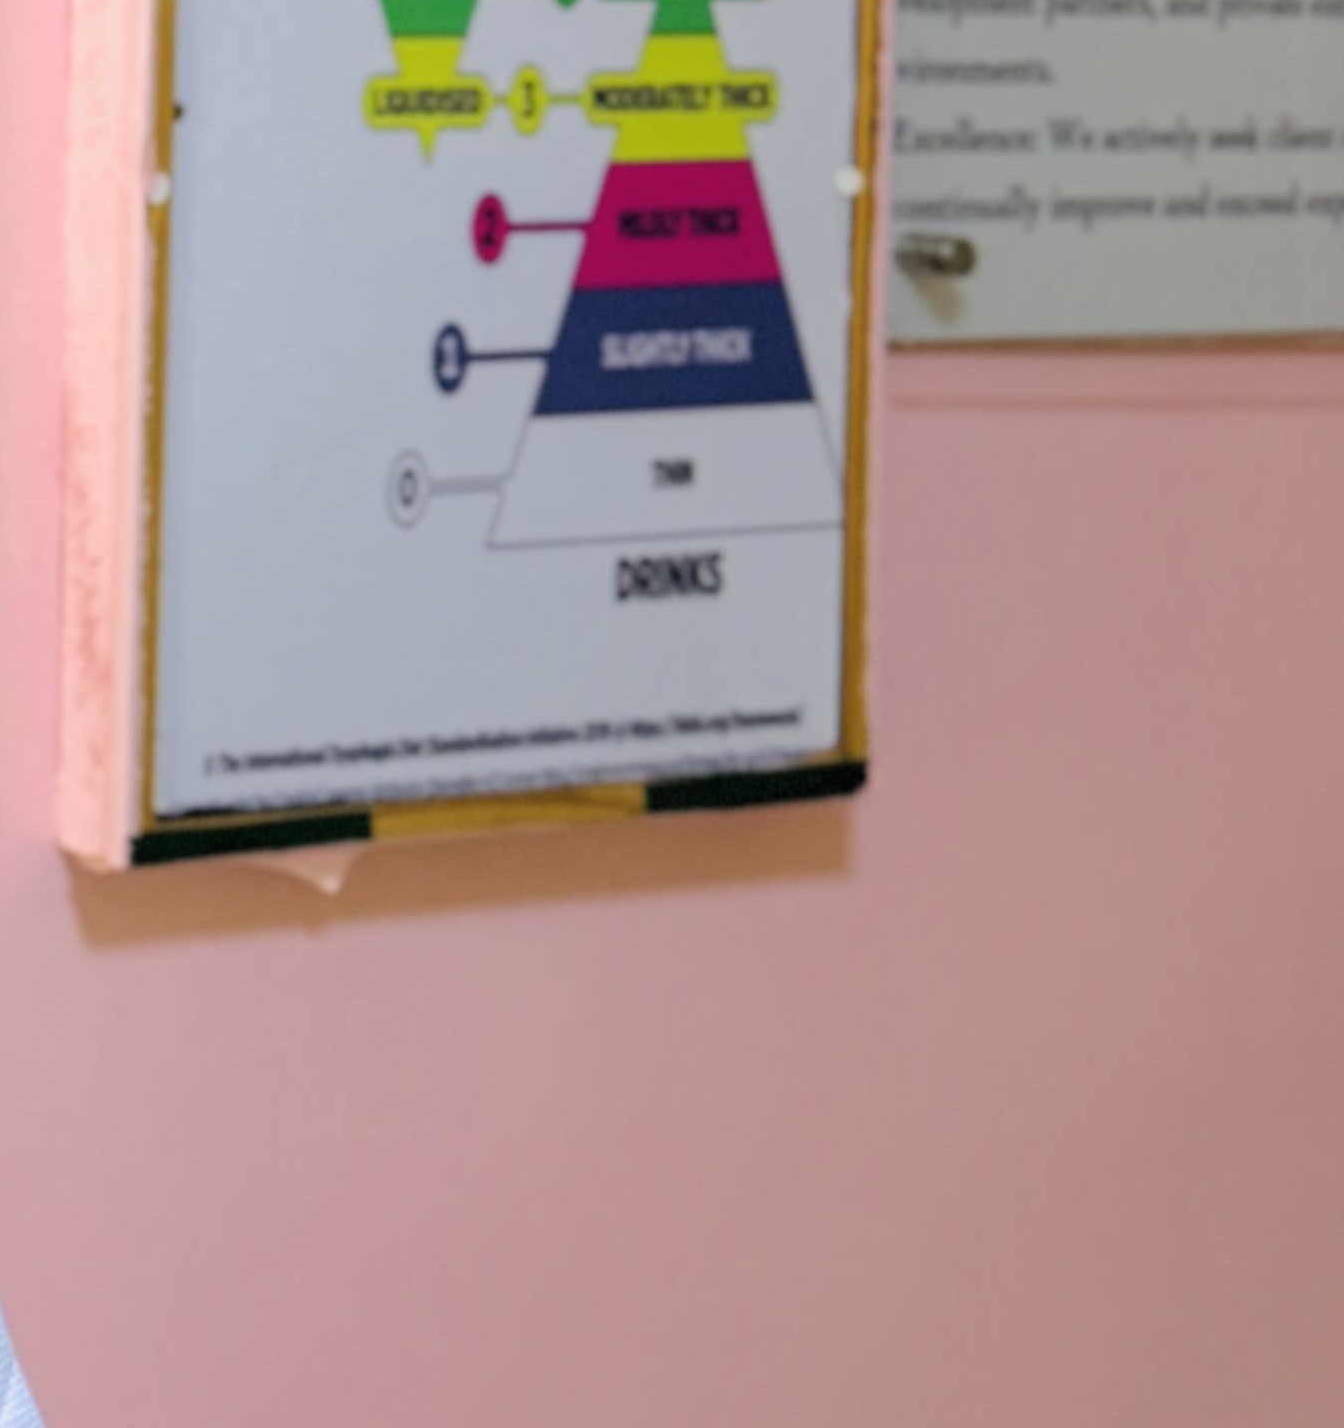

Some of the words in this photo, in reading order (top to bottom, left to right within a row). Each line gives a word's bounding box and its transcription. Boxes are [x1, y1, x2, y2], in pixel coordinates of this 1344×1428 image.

[521, 81, 536, 119] 3
[592, 85, 711, 113] MODERATELY
[719, 83, 770, 110] THICK
[482, 208, 497, 249] 2
[618, 209, 684, 241] MILDLY
[688, 205, 742, 237] THICK
[442, 339, 458, 379] 1
[599, 332, 691, 370] SLIGHTLY
[693, 327, 754, 363] THICK
[399, 469, 418, 508] 0
[651, 458, 696, 489] THIN
[616, 551, 723, 603] DRINKS
